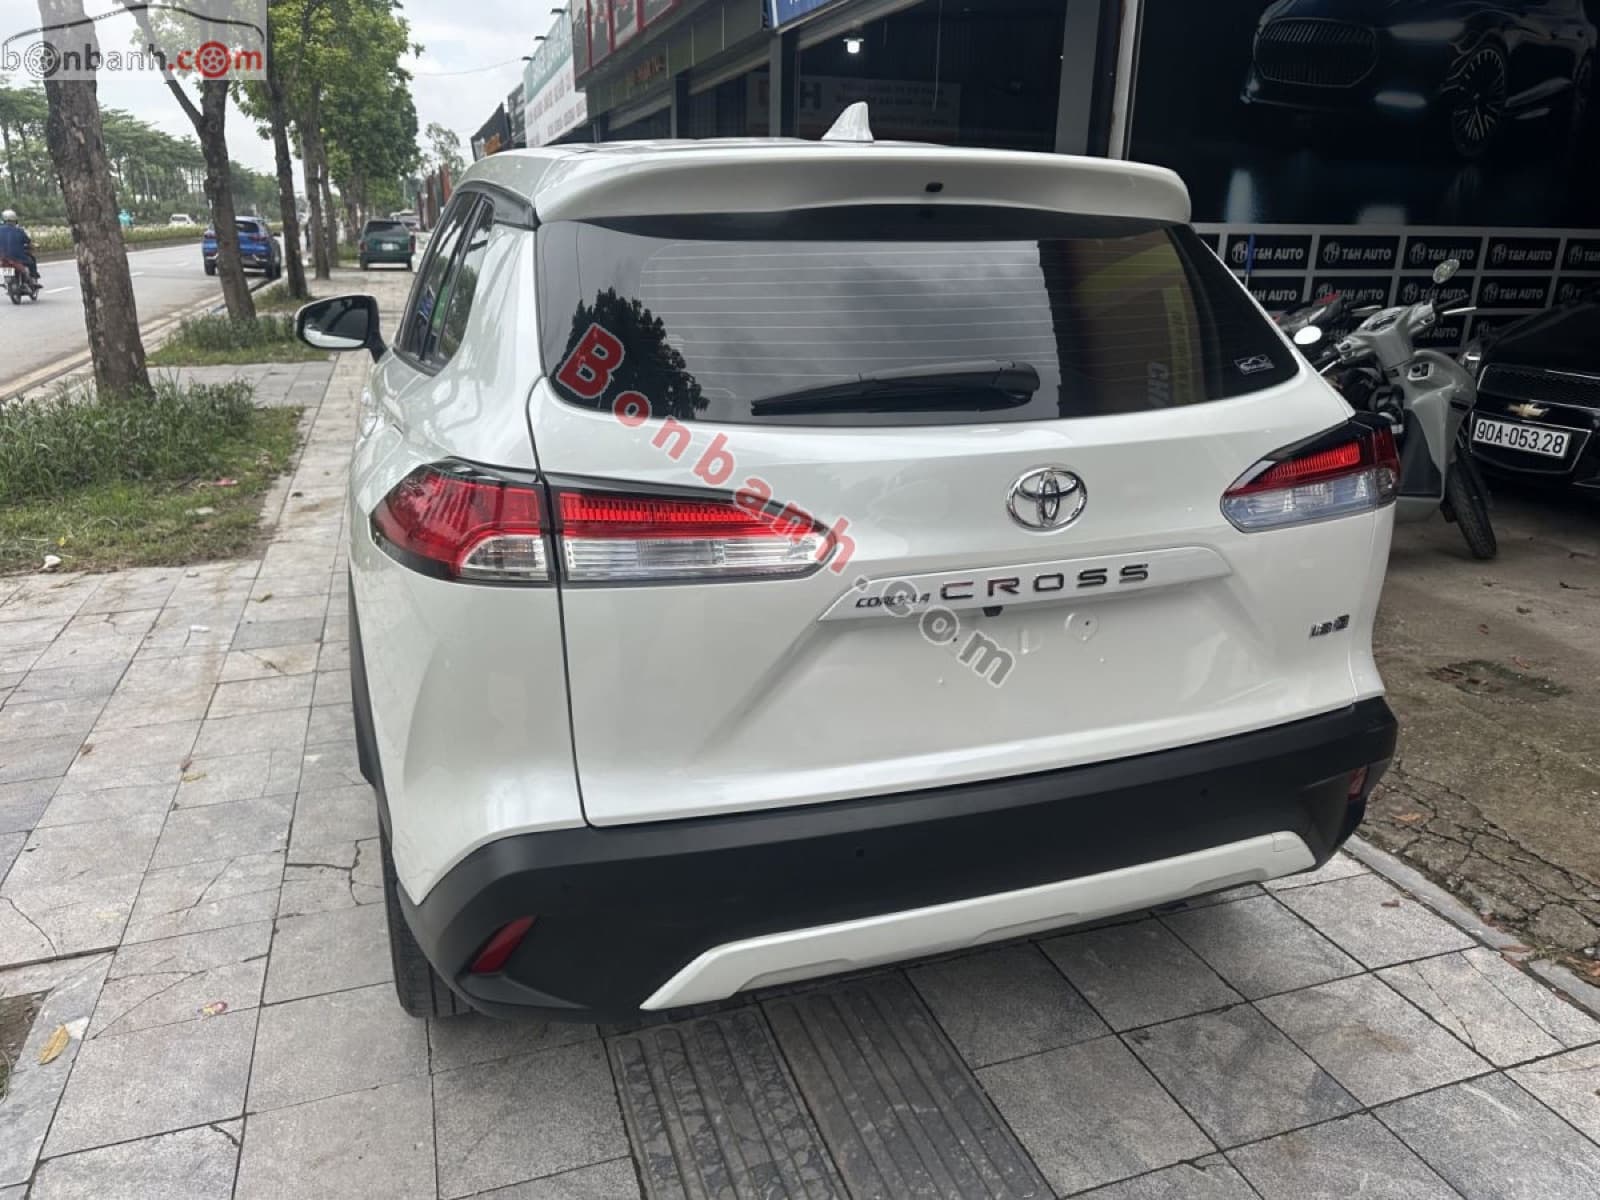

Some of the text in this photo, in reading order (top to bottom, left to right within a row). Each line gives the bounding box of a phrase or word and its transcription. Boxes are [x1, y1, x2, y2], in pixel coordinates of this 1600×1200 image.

[1254, 248, 1272, 260] T&H
[1273, 248, 1304, 260] AUTO
[1342, 249, 1363, 260] T&H
[1363, 249, 1392, 260] AUTO
[1428, 249, 1447, 260] T&H
[1447, 249, 1474, 261] AUTO
[1508, 250, 1527, 261] T&H
[1527, 250, 1553, 261] AUTO
[1250, 290, 1297, 300] &H AUTO
[1420, 289, 1439, 299] T&H
[1440, 289, 1467, 299] AUTO
[1500, 289, 1518, 299] T&H
[1518, 289, 1544, 299] AUTO
[1433, 327, 1458, 338] AUTO
[1476, 421, 1565, 454] 90A-053.28
[940, 563, 1149, 601] CROSS
